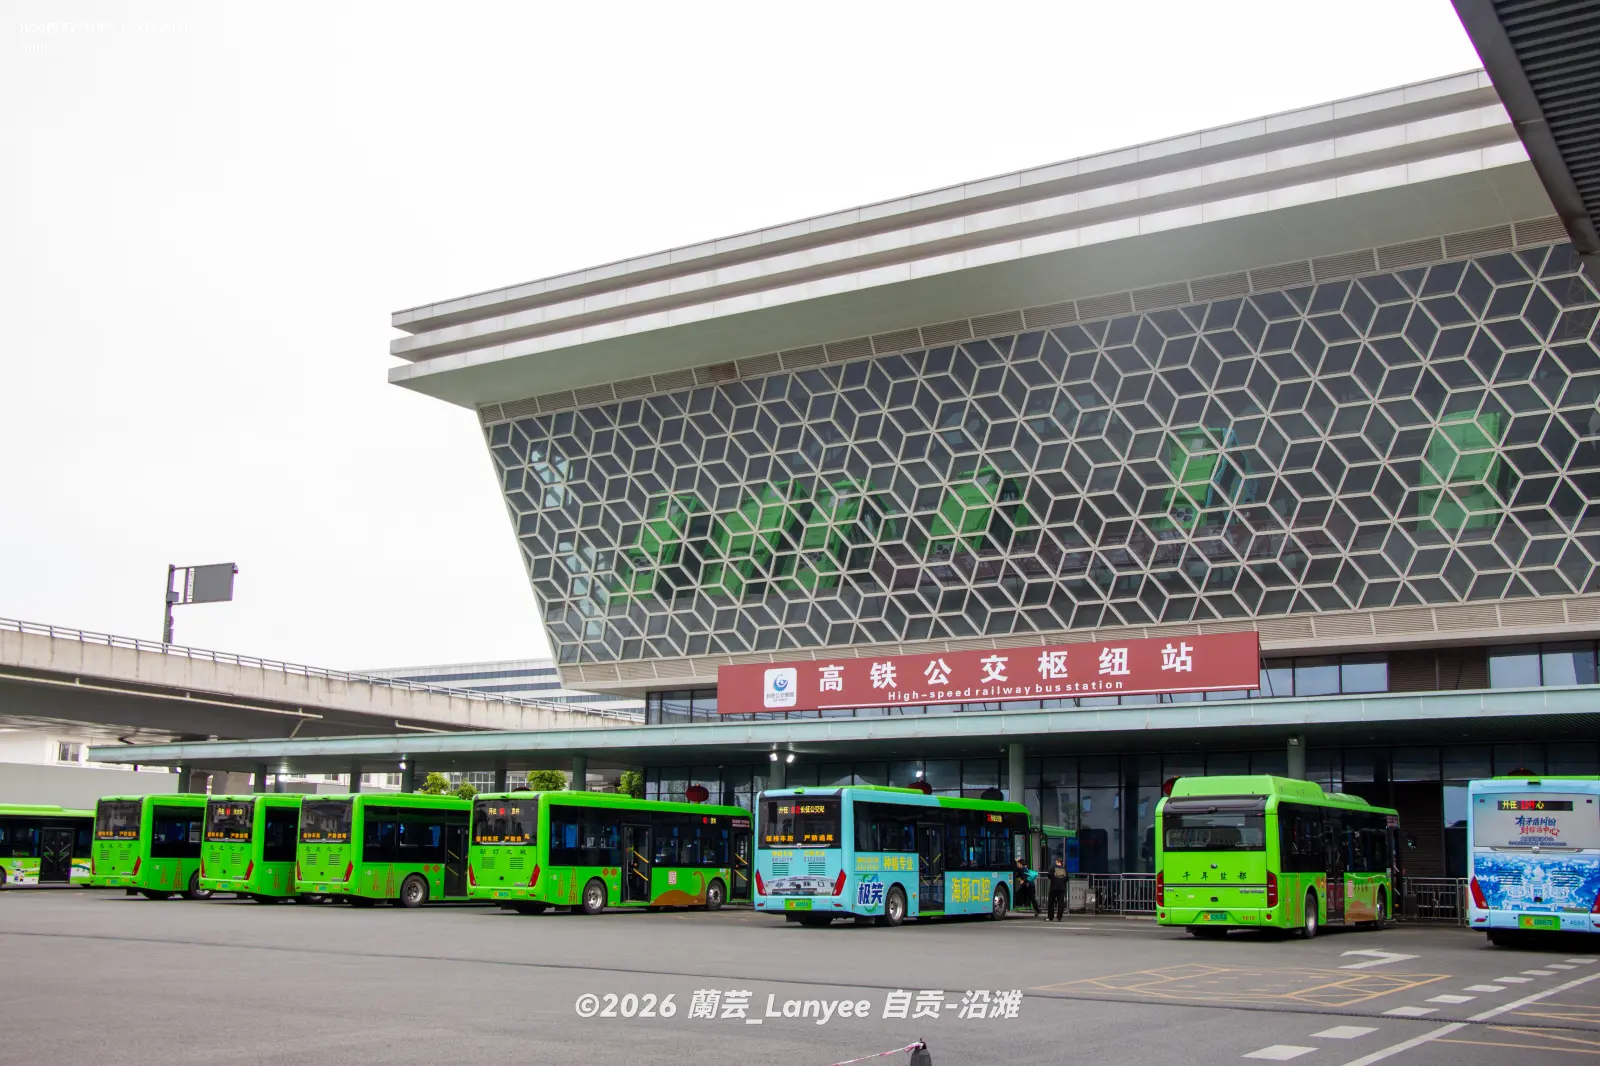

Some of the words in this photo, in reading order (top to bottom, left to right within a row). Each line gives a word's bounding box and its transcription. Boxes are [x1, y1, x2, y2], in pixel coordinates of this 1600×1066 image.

[819, 642, 1194, 692] 高铁公交枢纽站
[888, 687, 972, 703] High-speed
[974, 685, 1031, 699] railway
[1035, 683, 1062, 694] bus
[1066, 680, 1123, 692] station
[1514, 815, 1556, 827] 有矛盾纠纷
[803, 834, 834, 842] 严防追尾
[883, 856, 913, 871] 种植专业
[1182, 871, 1247, 881] 千年盐都
[858, 882, 884, 905] 极笑
[951, 877, 991, 903] 海豚口腔
